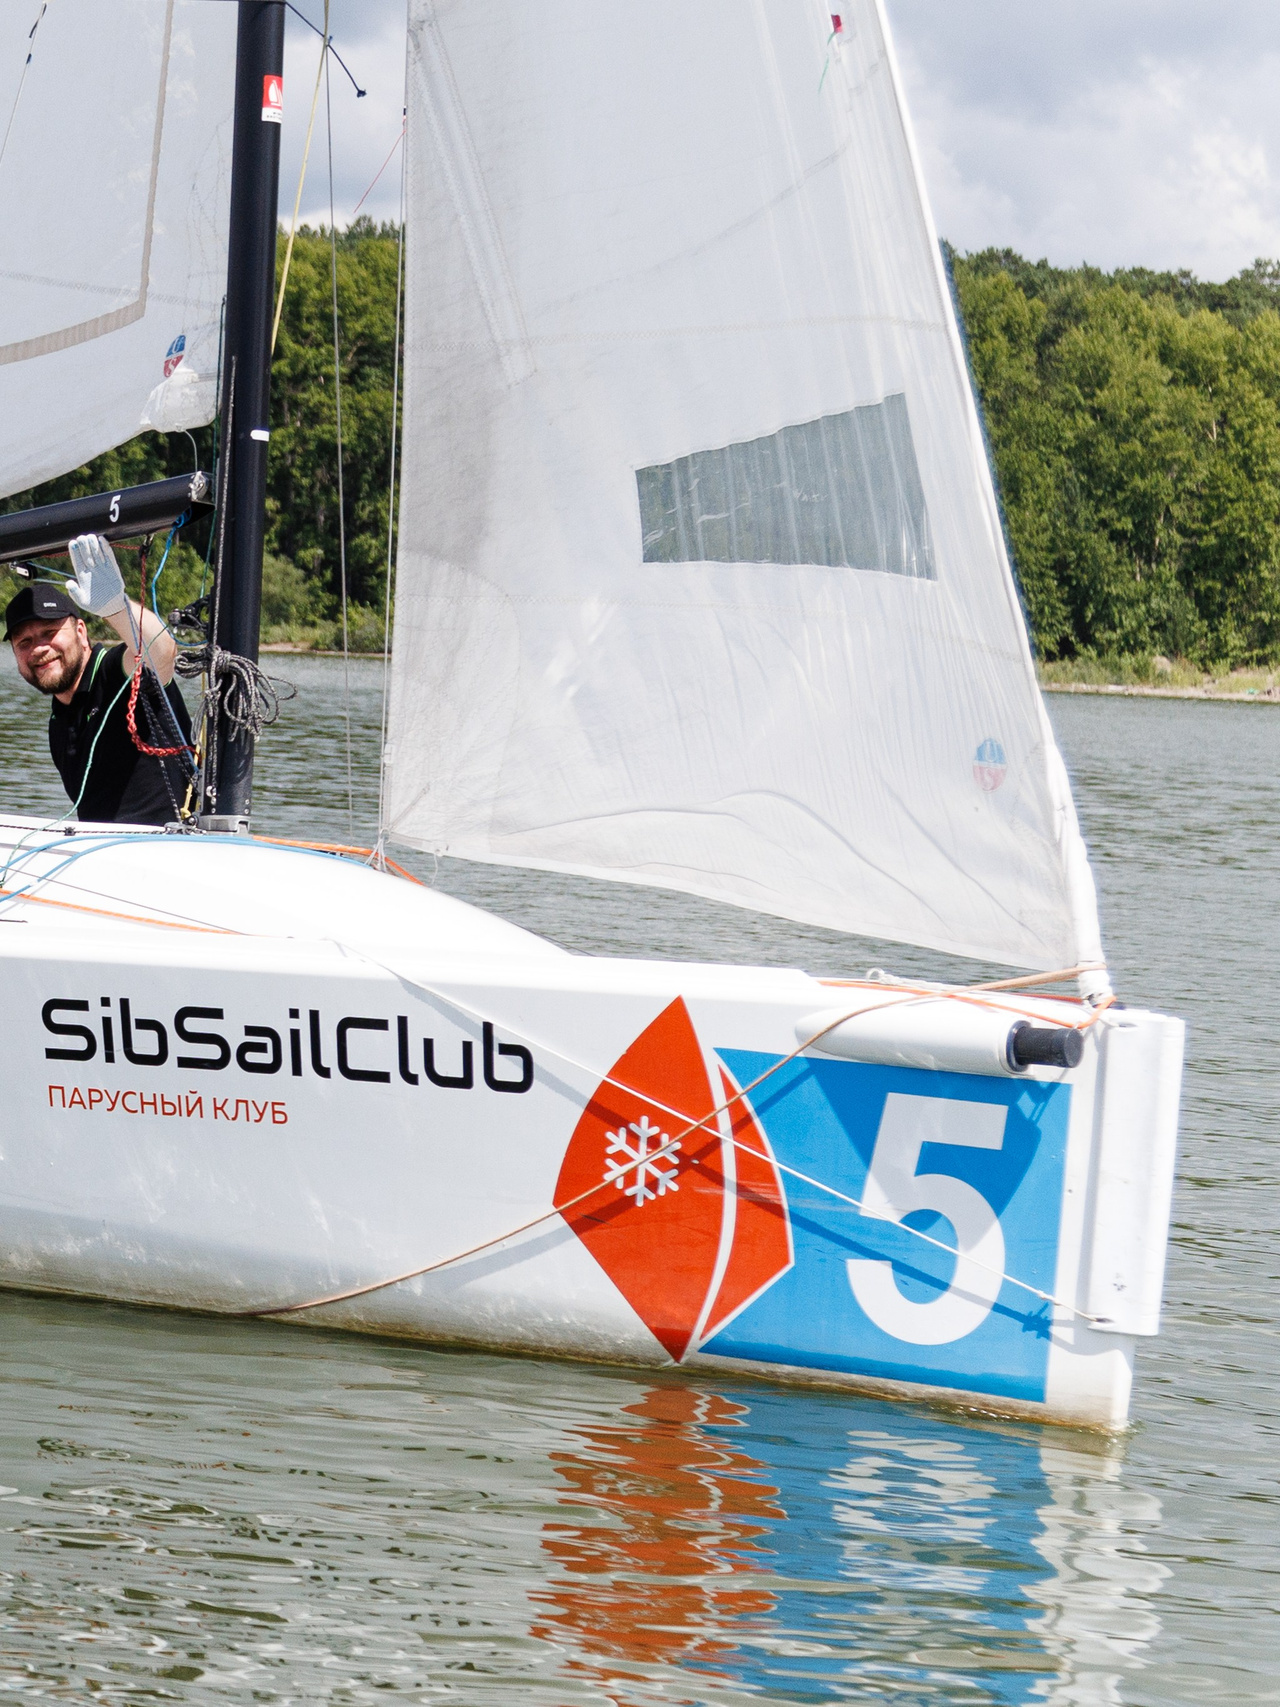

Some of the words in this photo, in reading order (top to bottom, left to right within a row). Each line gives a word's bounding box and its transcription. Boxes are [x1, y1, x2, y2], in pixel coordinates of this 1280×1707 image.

[109, 495, 121, 523] 5
[41, 996, 534, 1094] SibSailClub
[48, 1085, 204, 1120] ПАРУСНЫЙ
[212, 1099, 288, 1125] КЛУБ
[845, 1092, 1008, 1346] 5
